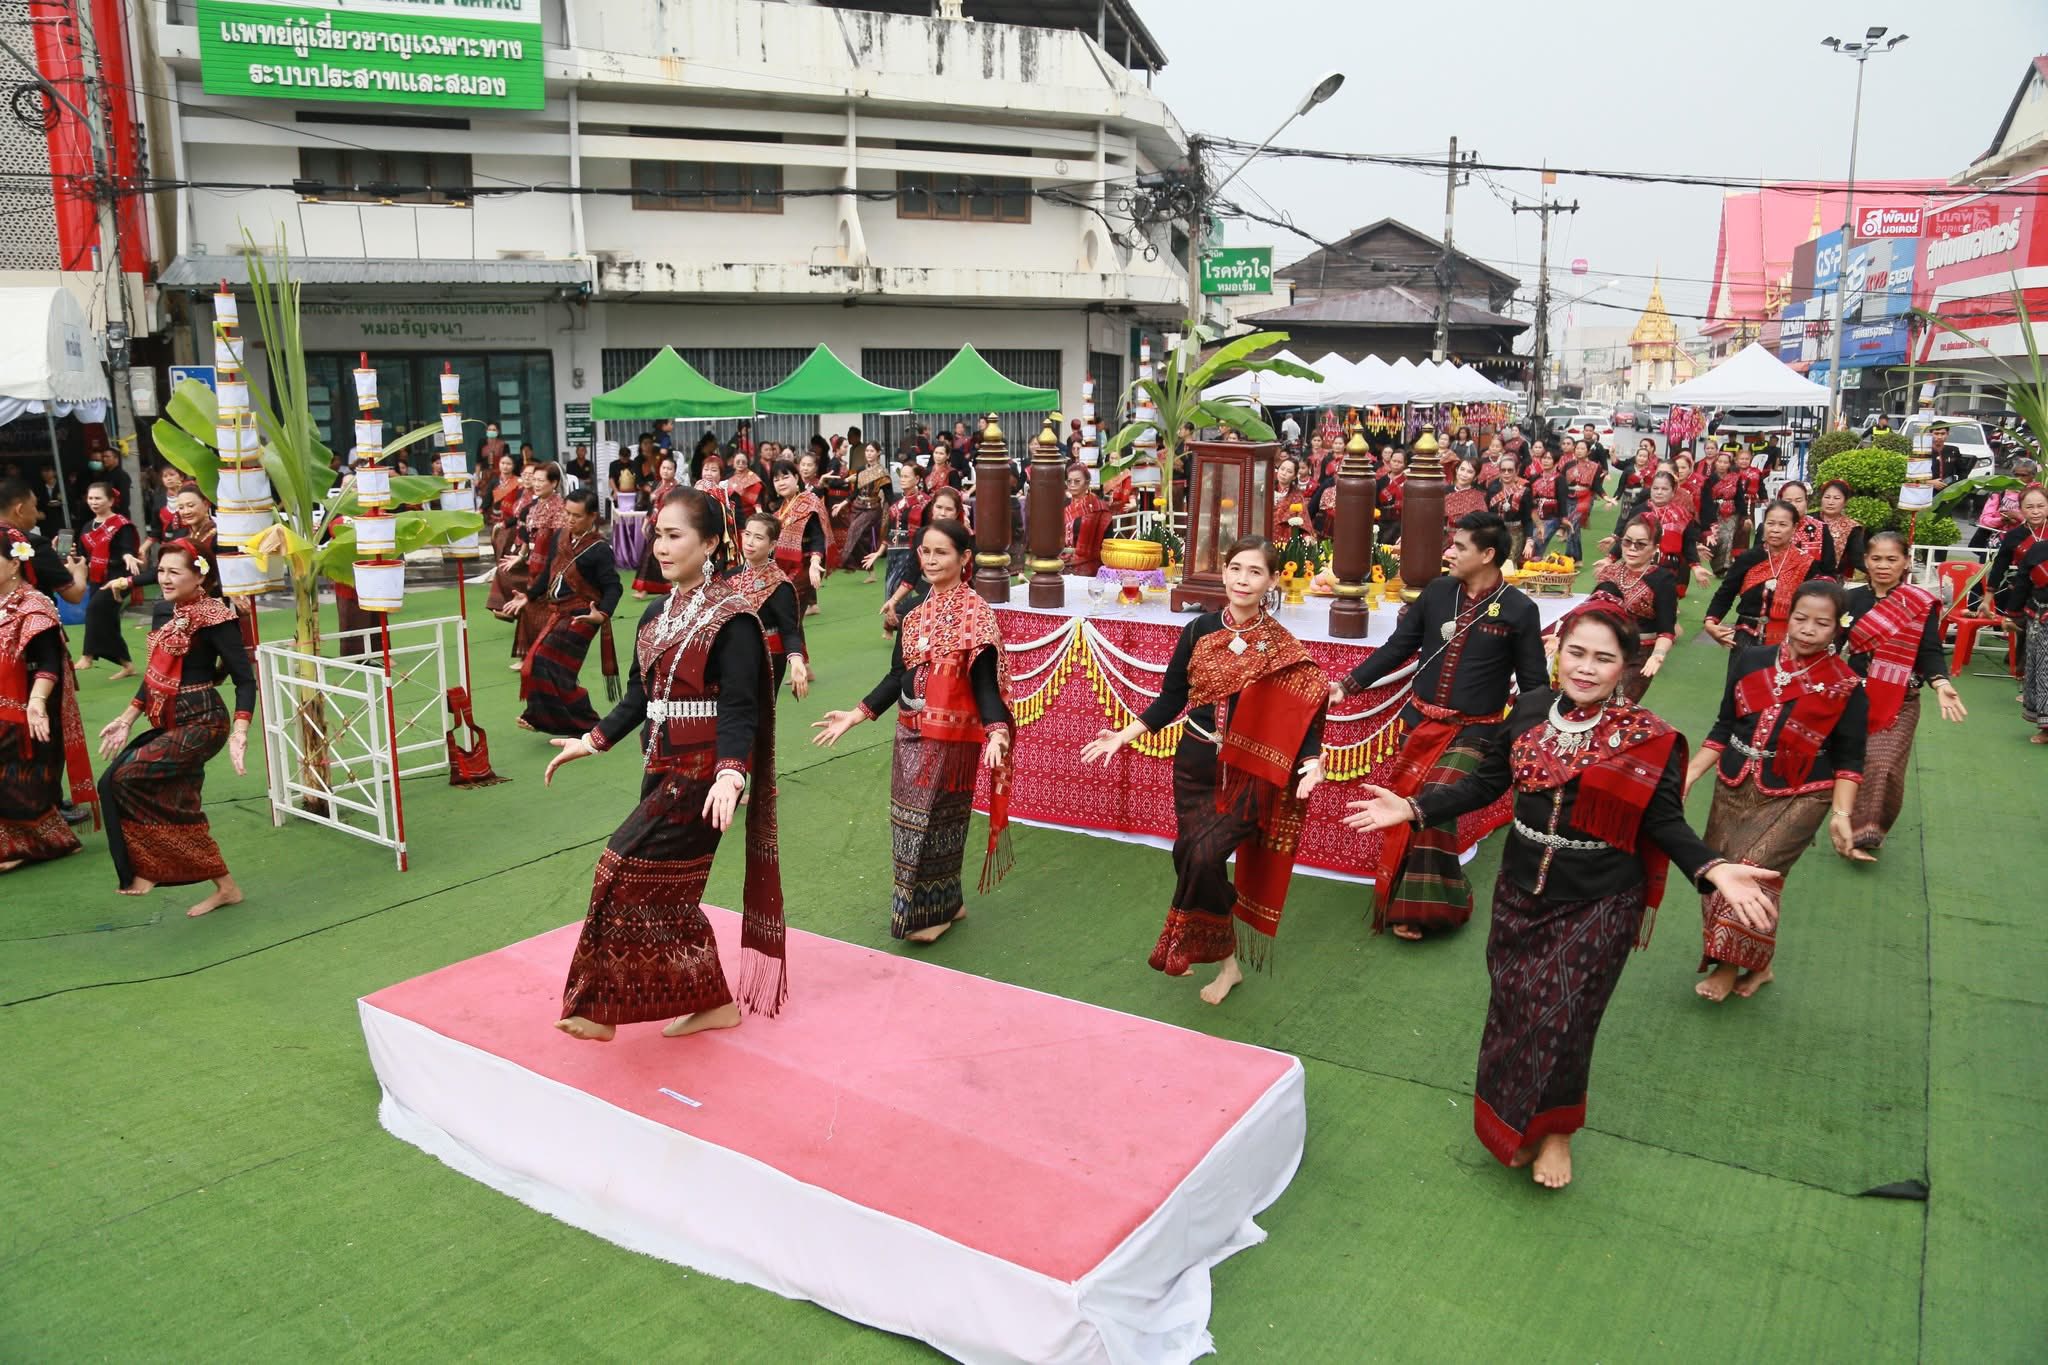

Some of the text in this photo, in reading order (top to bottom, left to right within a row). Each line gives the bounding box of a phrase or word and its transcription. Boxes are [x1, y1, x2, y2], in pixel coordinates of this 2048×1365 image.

[220, 13, 523, 60] แพทย์ผู้เชี่ยวชาญเฉพาะทาง
[249, 63, 507, 97] ระบบประสาทและสมอง
[1203, 257, 1270, 279] โรคหัวใจ
